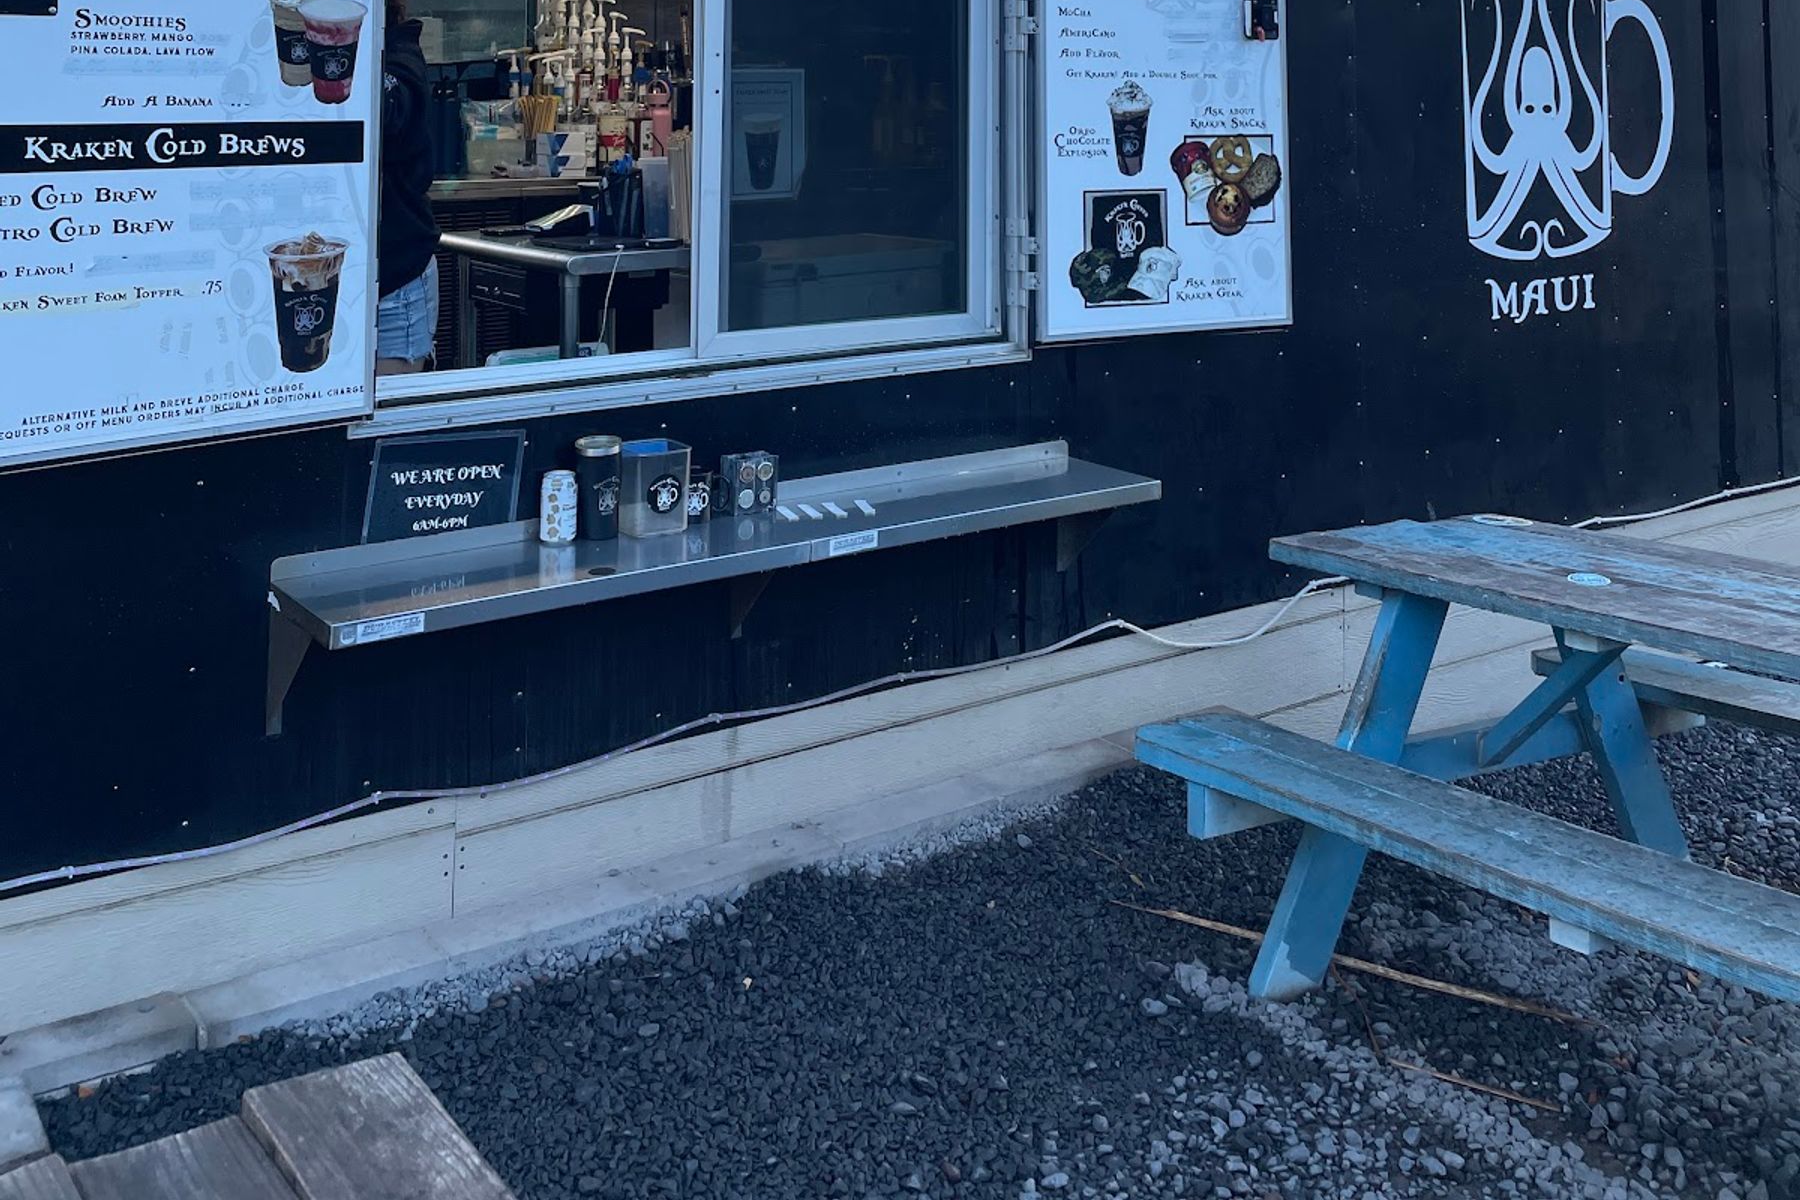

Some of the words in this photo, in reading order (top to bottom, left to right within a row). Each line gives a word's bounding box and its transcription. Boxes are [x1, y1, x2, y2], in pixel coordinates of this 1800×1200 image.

[1057, 6, 1091, 17] MOCHA
[75, 8, 186, 31] SMOOTHIES
[1058, 27, 1116, 38] AMERICANO
[71, 45, 98, 55] PINA
[156, 47, 180, 56] LAVA
[185, 48, 216, 56] FLOW
[1059, 48, 1081, 58] ADD
[1085, 48, 1121, 59] FLAVOR
[101, 95, 135, 107] ADD
[142, 95, 158, 107] A
[165, 96, 213, 107] BANANA
[1202, 106, 1224, 116] ASK
[1069, 126, 1096, 135] OREO
[1190, 118, 1226, 129] KRAKEN
[1231, 117, 1266, 129] SNACKS
[24, 136, 134, 163] KRAKEN
[145, 128, 206, 163] COLD
[219, 133, 305, 158] BREWS
[1054, 133, 1111, 148] CHOCOLATE
[1058, 148, 1108, 158] EXPLOSION
[31, 184, 83, 211] COLD
[95, 187, 157, 203] BREW
[49, 217, 100, 243] COLD
[113, 219, 174, 234] BREW
[15, 263, 73, 277] FLAVOR!
[1184, 278, 1206, 288] ASK
[37, 295, 88, 310] SWEET
[95, 292, 127, 303] FOAM
[134, 287, 184, 299] TOPPER
[202, 281, 222, 294] .75
[1176, 290, 1213, 302] KRAKEN
[1216, 287, 1243, 297] GEAR
[1485, 273, 1595, 324] MAUI
[21, 410, 96, 426] ALTERNATIVE
[101, 404, 128, 416] MILK
[133, 402, 155, 412] AND
[160, 397, 192, 408] BREVE
[198, 387, 260, 403] ADDITIONAL
[264, 383, 304, 394] CHARGE
[54, 424, 71, 433] OR
[76, 420, 97, 430] OFF
[101, 416, 132, 427] MENU
[137, 410, 180, 422] ORDERS
[185, 406, 206, 416] MAY
[211, 401, 241, 412] INCUR
[247, 399, 260, 408] AN
[264, 390, 323, 405] ADDITIONAL
[327, 385, 364, 396] CHARGE
[390, 470, 419, 486] WE
[418, 468, 456, 484] ARE
[457, 464, 505, 480] OPEN
[404, 491, 484, 510] EVERYDAY
[412, 514, 469, 531] 6AM-6PM
